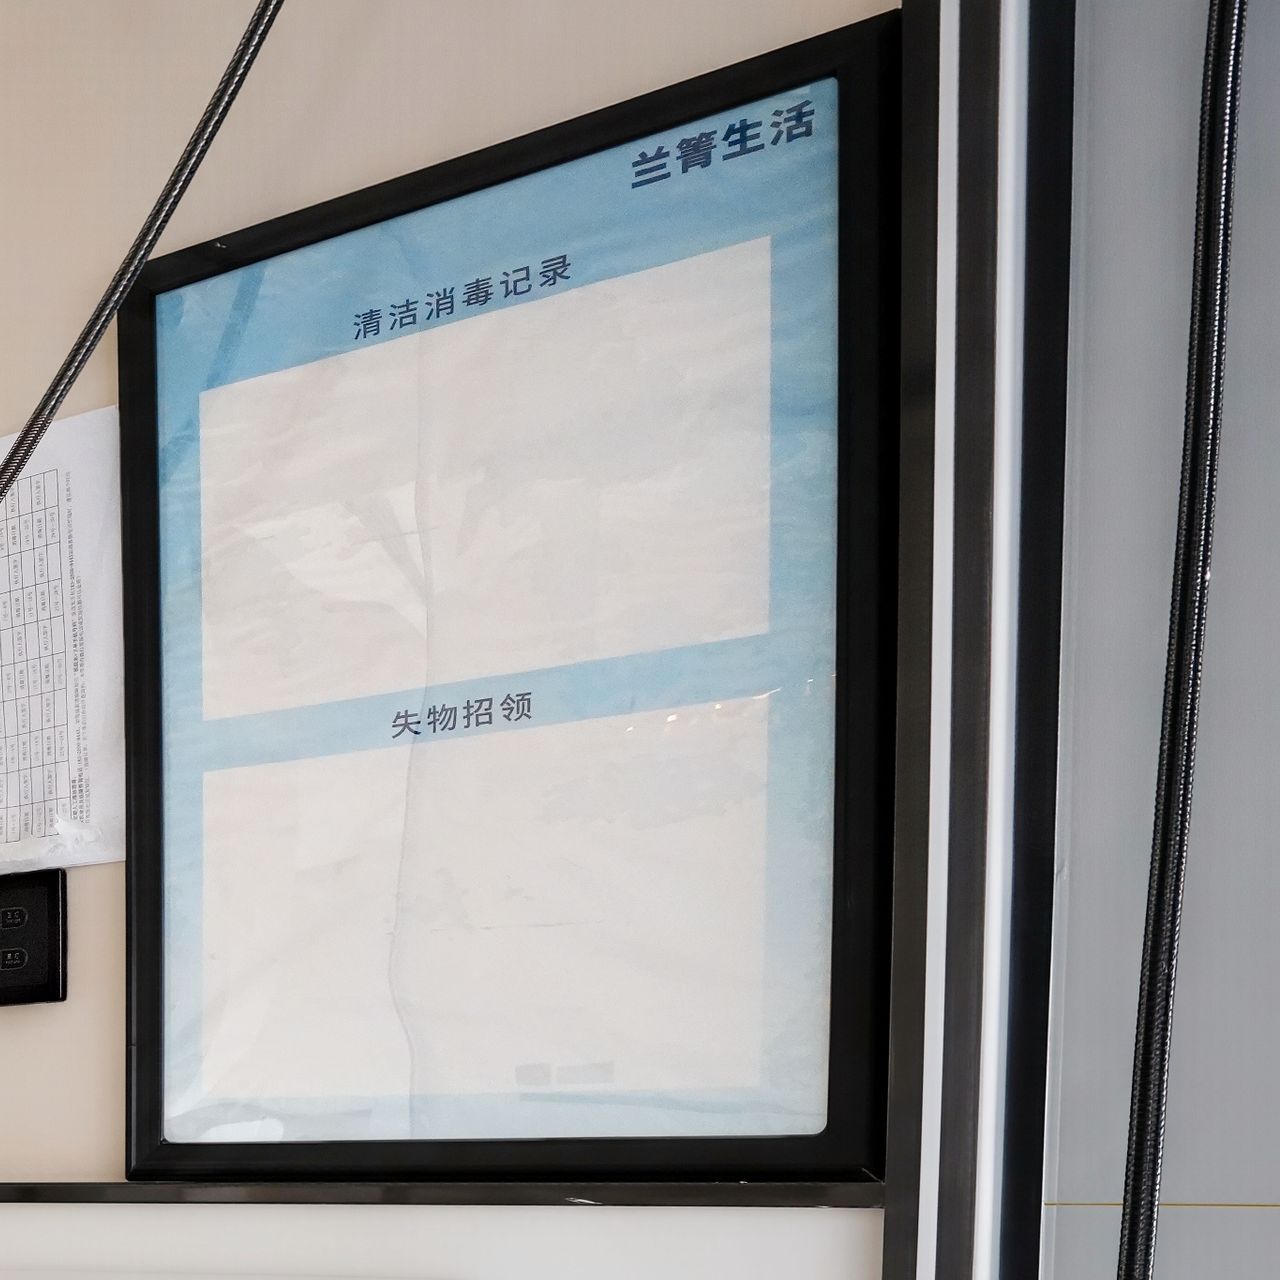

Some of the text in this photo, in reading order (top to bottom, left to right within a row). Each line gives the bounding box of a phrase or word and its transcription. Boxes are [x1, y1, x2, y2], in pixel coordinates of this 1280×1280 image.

[630, 98, 816, 190] 兰箐生活
[352, 253, 572, 341] 清洁消毒记录
[390, 690, 534, 739] 失物招领
